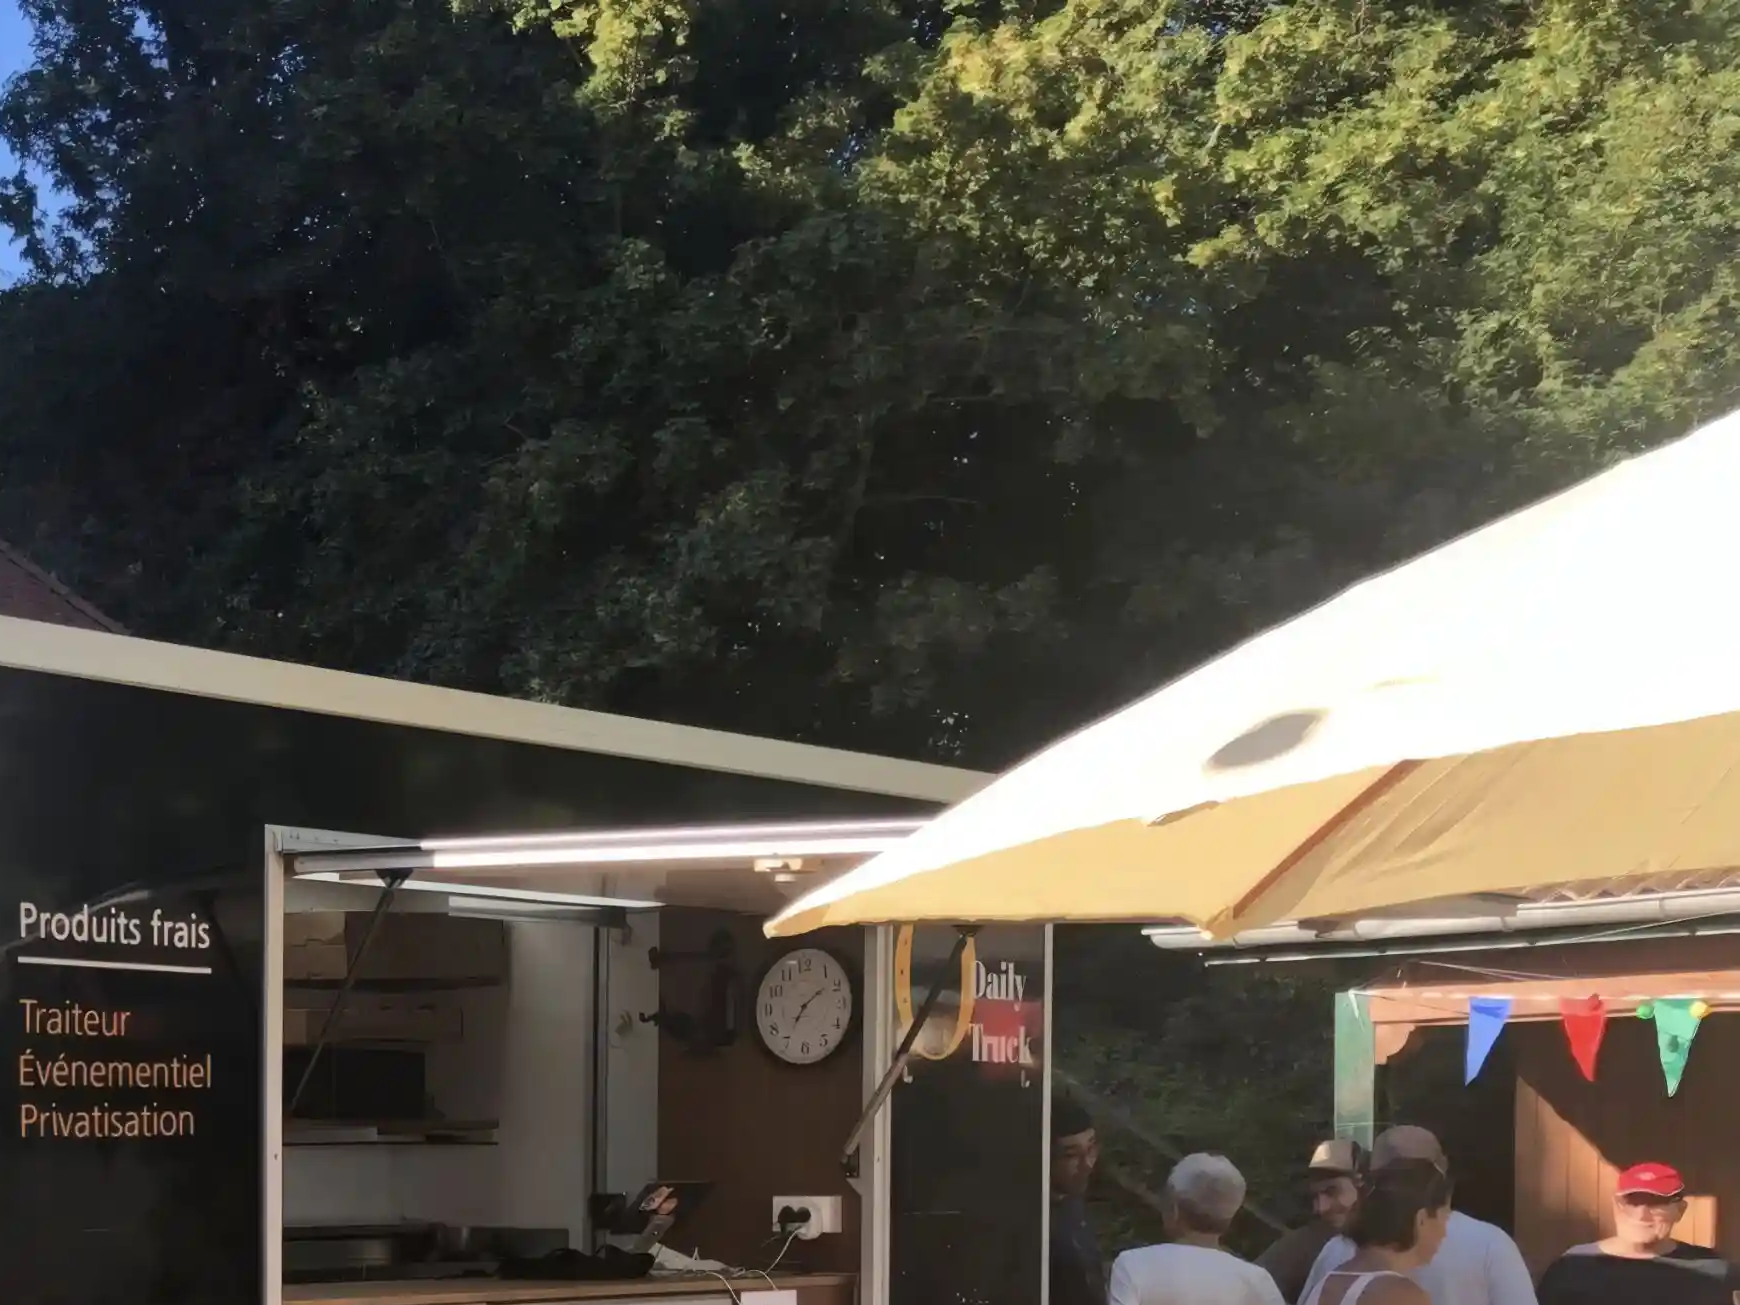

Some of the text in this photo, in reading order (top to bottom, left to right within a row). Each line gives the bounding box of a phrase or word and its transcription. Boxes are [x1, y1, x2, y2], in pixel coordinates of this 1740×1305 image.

[18, 901, 211, 949] Produits frais
[971, 960, 1027, 1012] Daily
[19, 998, 131, 1037] Traiteur
[968, 1020, 1034, 1064] Truck
[18, 1048, 212, 1089] Événementiel
[20, 1101, 195, 1138] Privatisation
